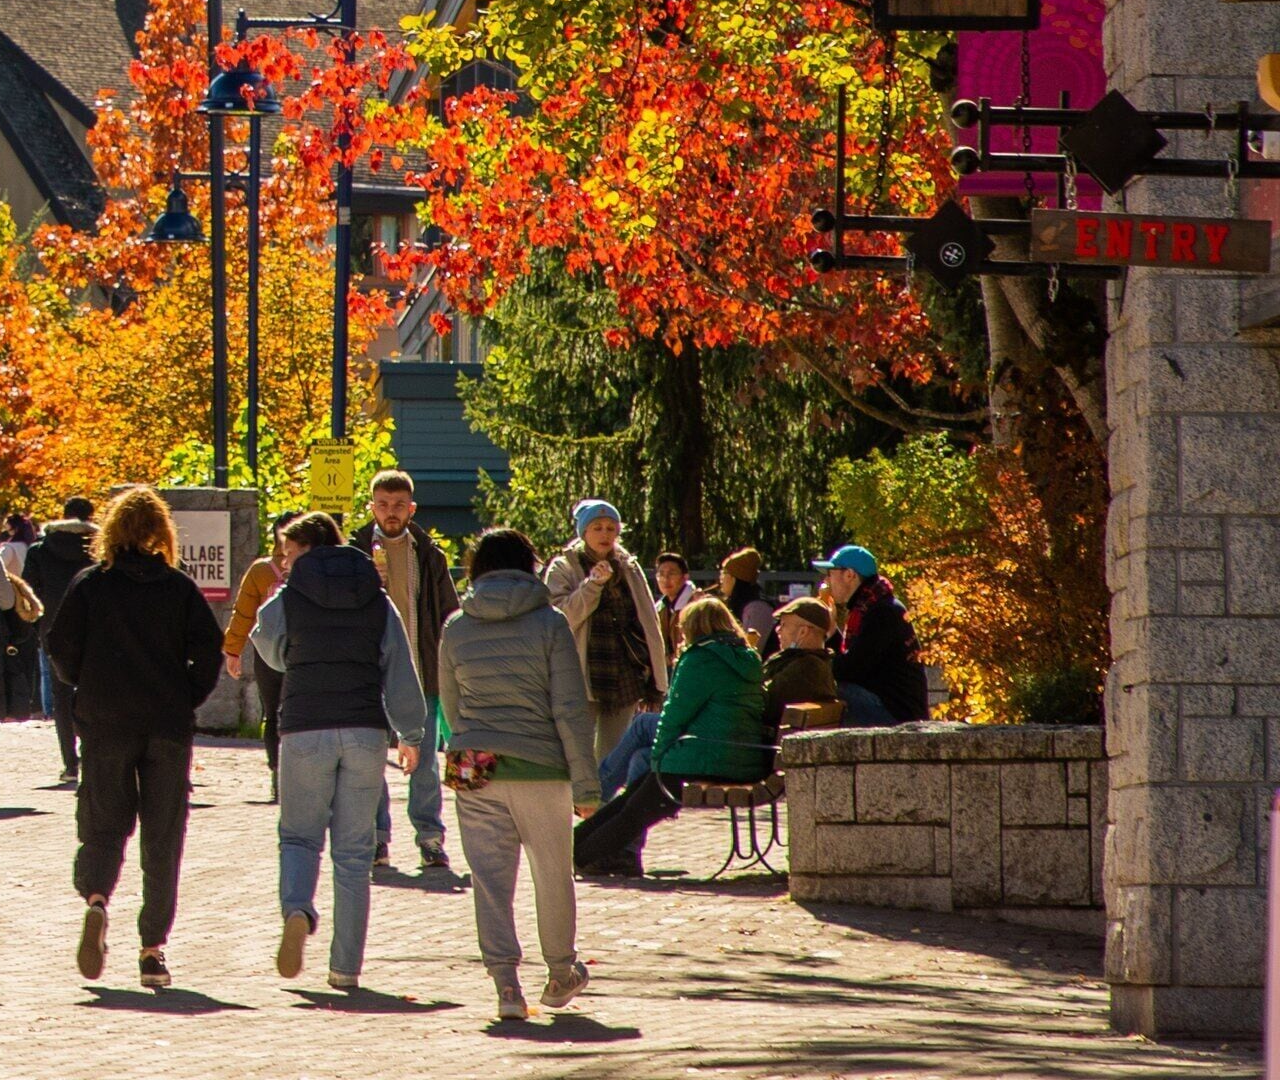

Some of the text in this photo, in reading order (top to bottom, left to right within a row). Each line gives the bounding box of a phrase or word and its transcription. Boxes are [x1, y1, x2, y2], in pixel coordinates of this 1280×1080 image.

[1074, 218, 1229, 264] ENTRY
[314, 447, 352, 456] Congested
[320, 503, 344, 511] Moving
[178, 545, 225, 561] LLAGE
[185, 564, 225, 580] NTRE
